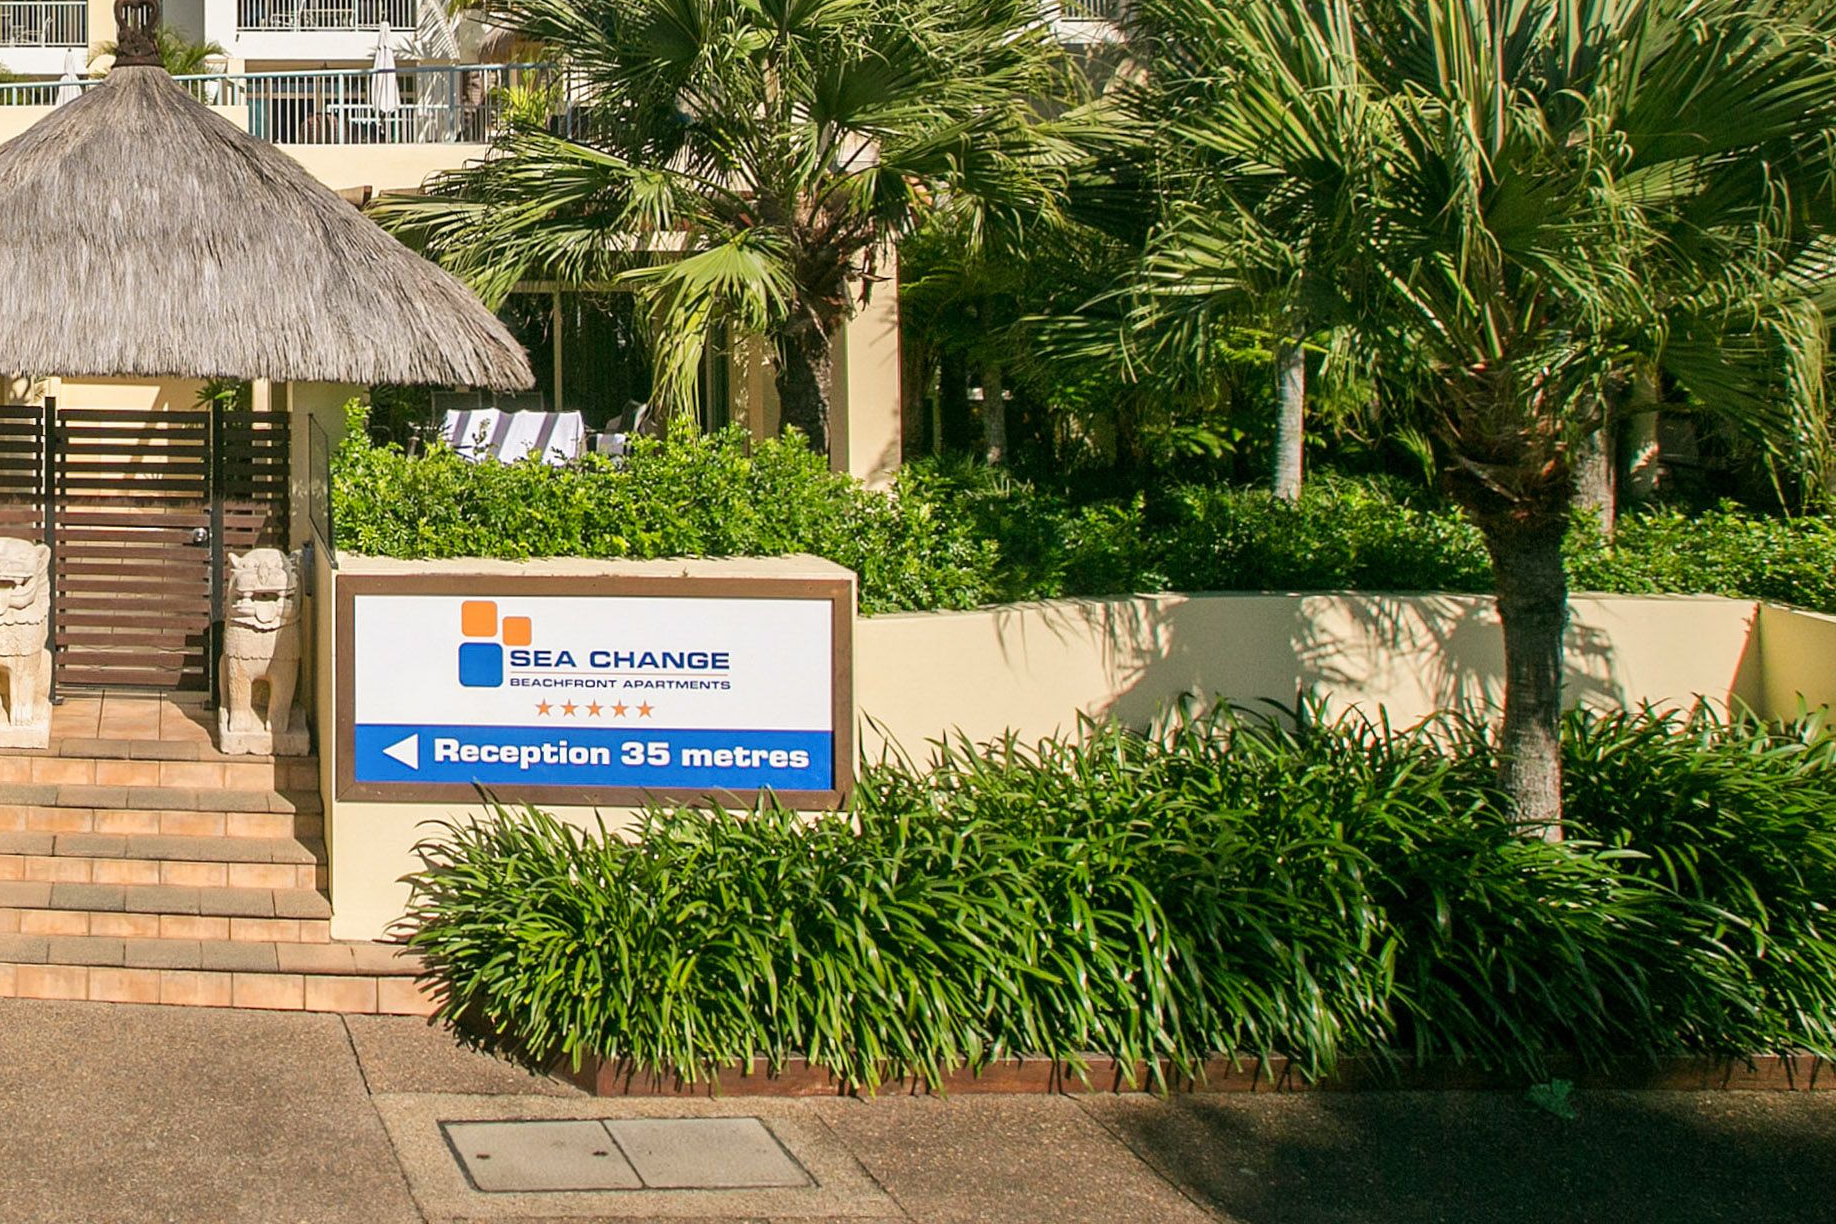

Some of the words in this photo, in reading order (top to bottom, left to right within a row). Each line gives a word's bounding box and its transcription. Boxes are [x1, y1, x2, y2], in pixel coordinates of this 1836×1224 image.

[509, 649, 577, 668] SEA
[589, 650, 731, 670] CHANGE
[509, 677, 617, 689] BEACHFRONT
[622, 679, 731, 690] APARTMENTS
[434, 738, 610, 770] Reception
[620, 741, 671, 767] 35
[681, 746, 810, 768] metres
